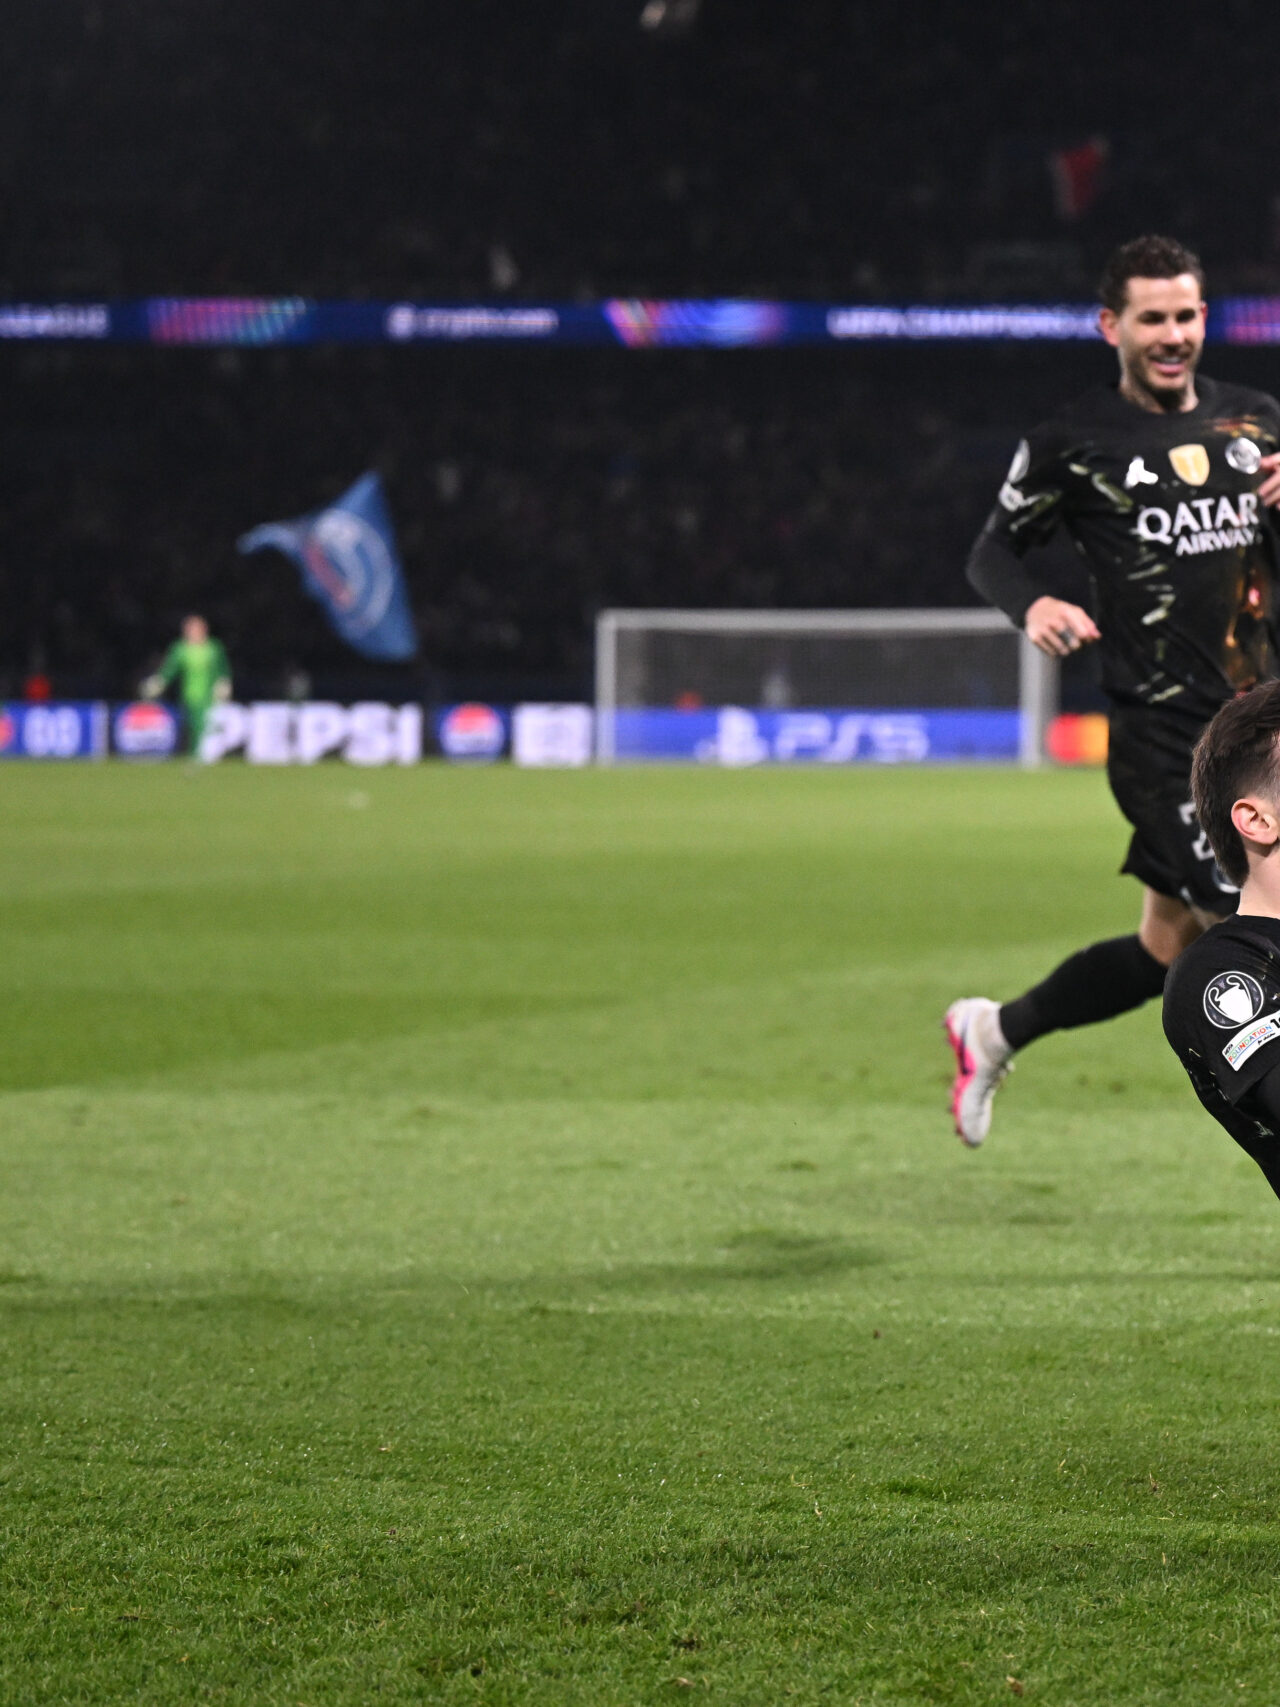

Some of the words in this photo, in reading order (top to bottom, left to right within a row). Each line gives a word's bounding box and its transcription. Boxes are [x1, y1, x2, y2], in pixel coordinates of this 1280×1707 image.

[1137, 493, 1259, 545] QATAR
[200, 703, 422, 764] PEPSI
[774, 712, 929, 762] PS5
[1228, 1024, 1272, 1063] FOUNDATION
